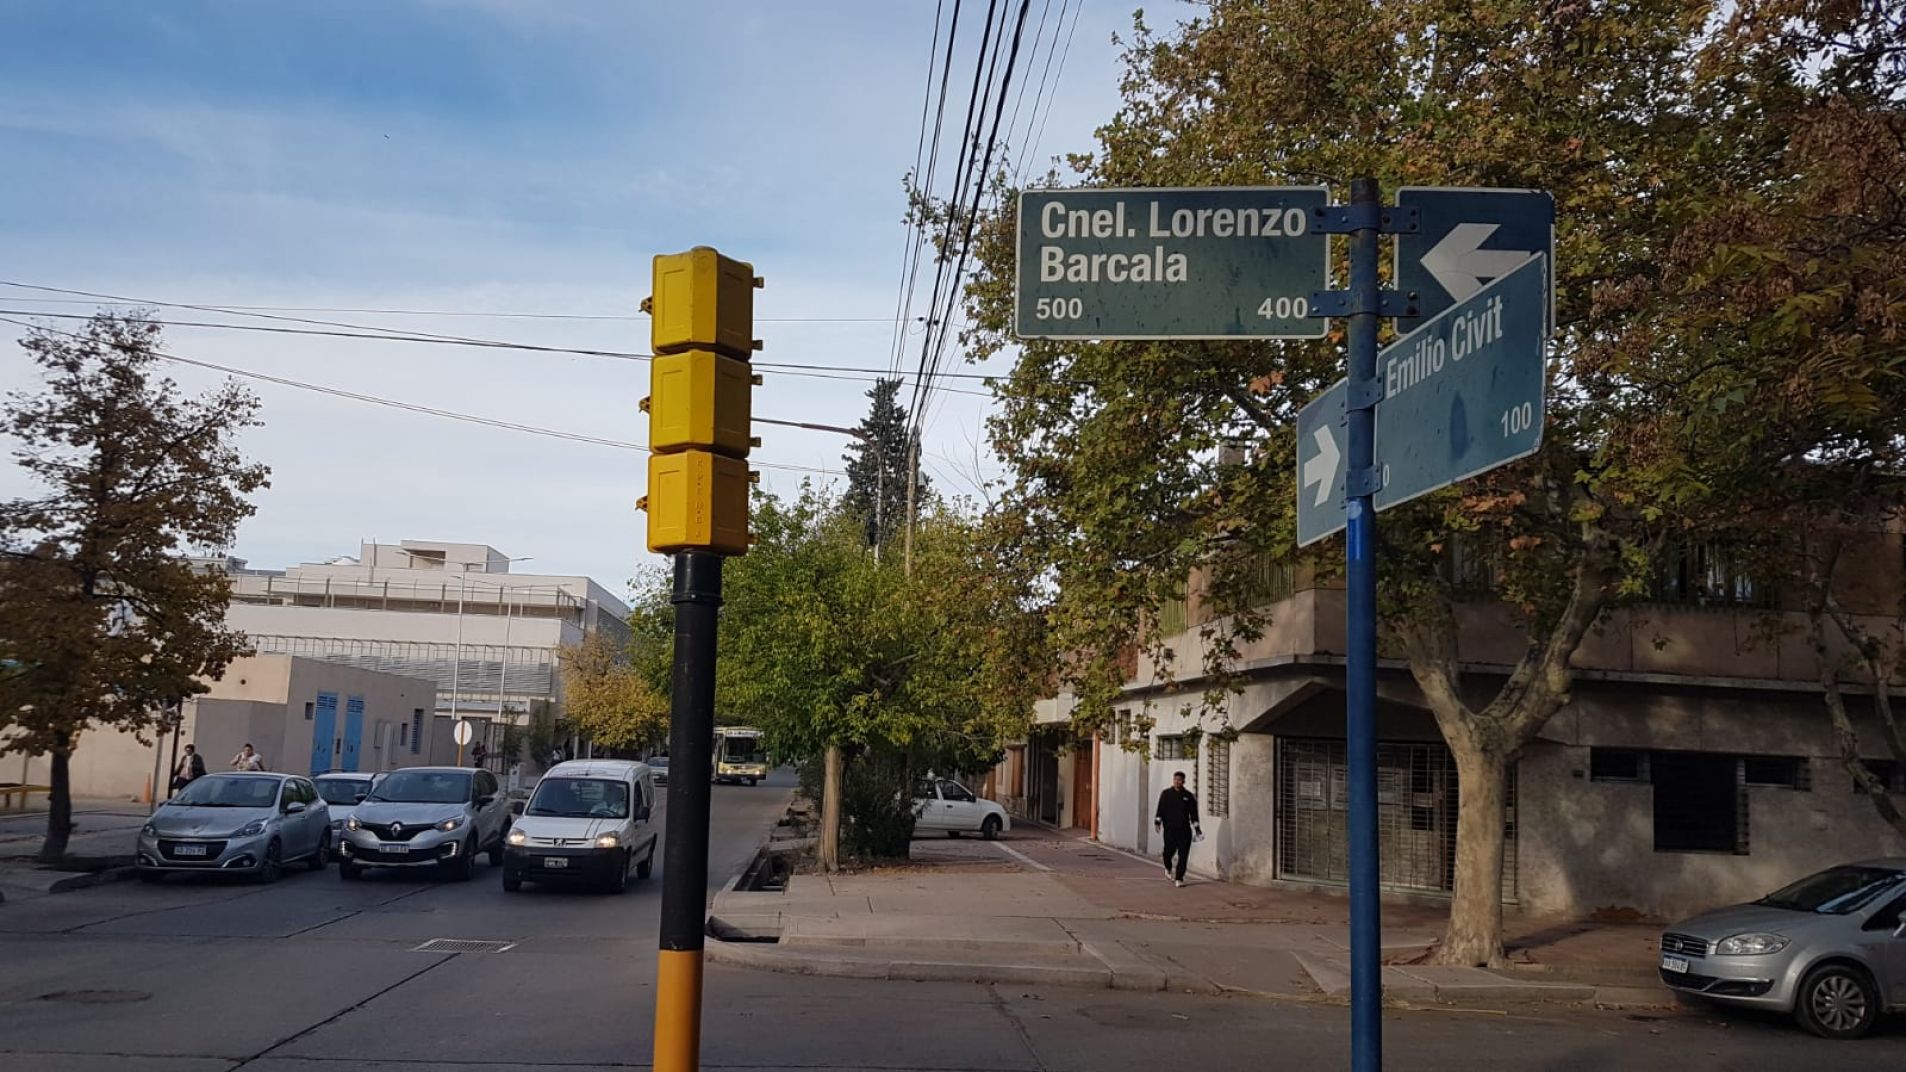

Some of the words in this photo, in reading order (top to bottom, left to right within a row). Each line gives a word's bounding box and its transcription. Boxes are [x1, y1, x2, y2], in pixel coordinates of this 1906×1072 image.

[1041, 201, 1136, 239] Cnel.
[1149, 201, 1306, 238] Lorenzo
[1040, 245, 1188, 283] Barcala
[1035, 297, 1083, 320] 500
[1257, 297, 1308, 320] 400
[1386, 334, 1446, 400] Emilio
[1451, 295, 1503, 361] Civit
[1501, 401, 1532, 438] 100
